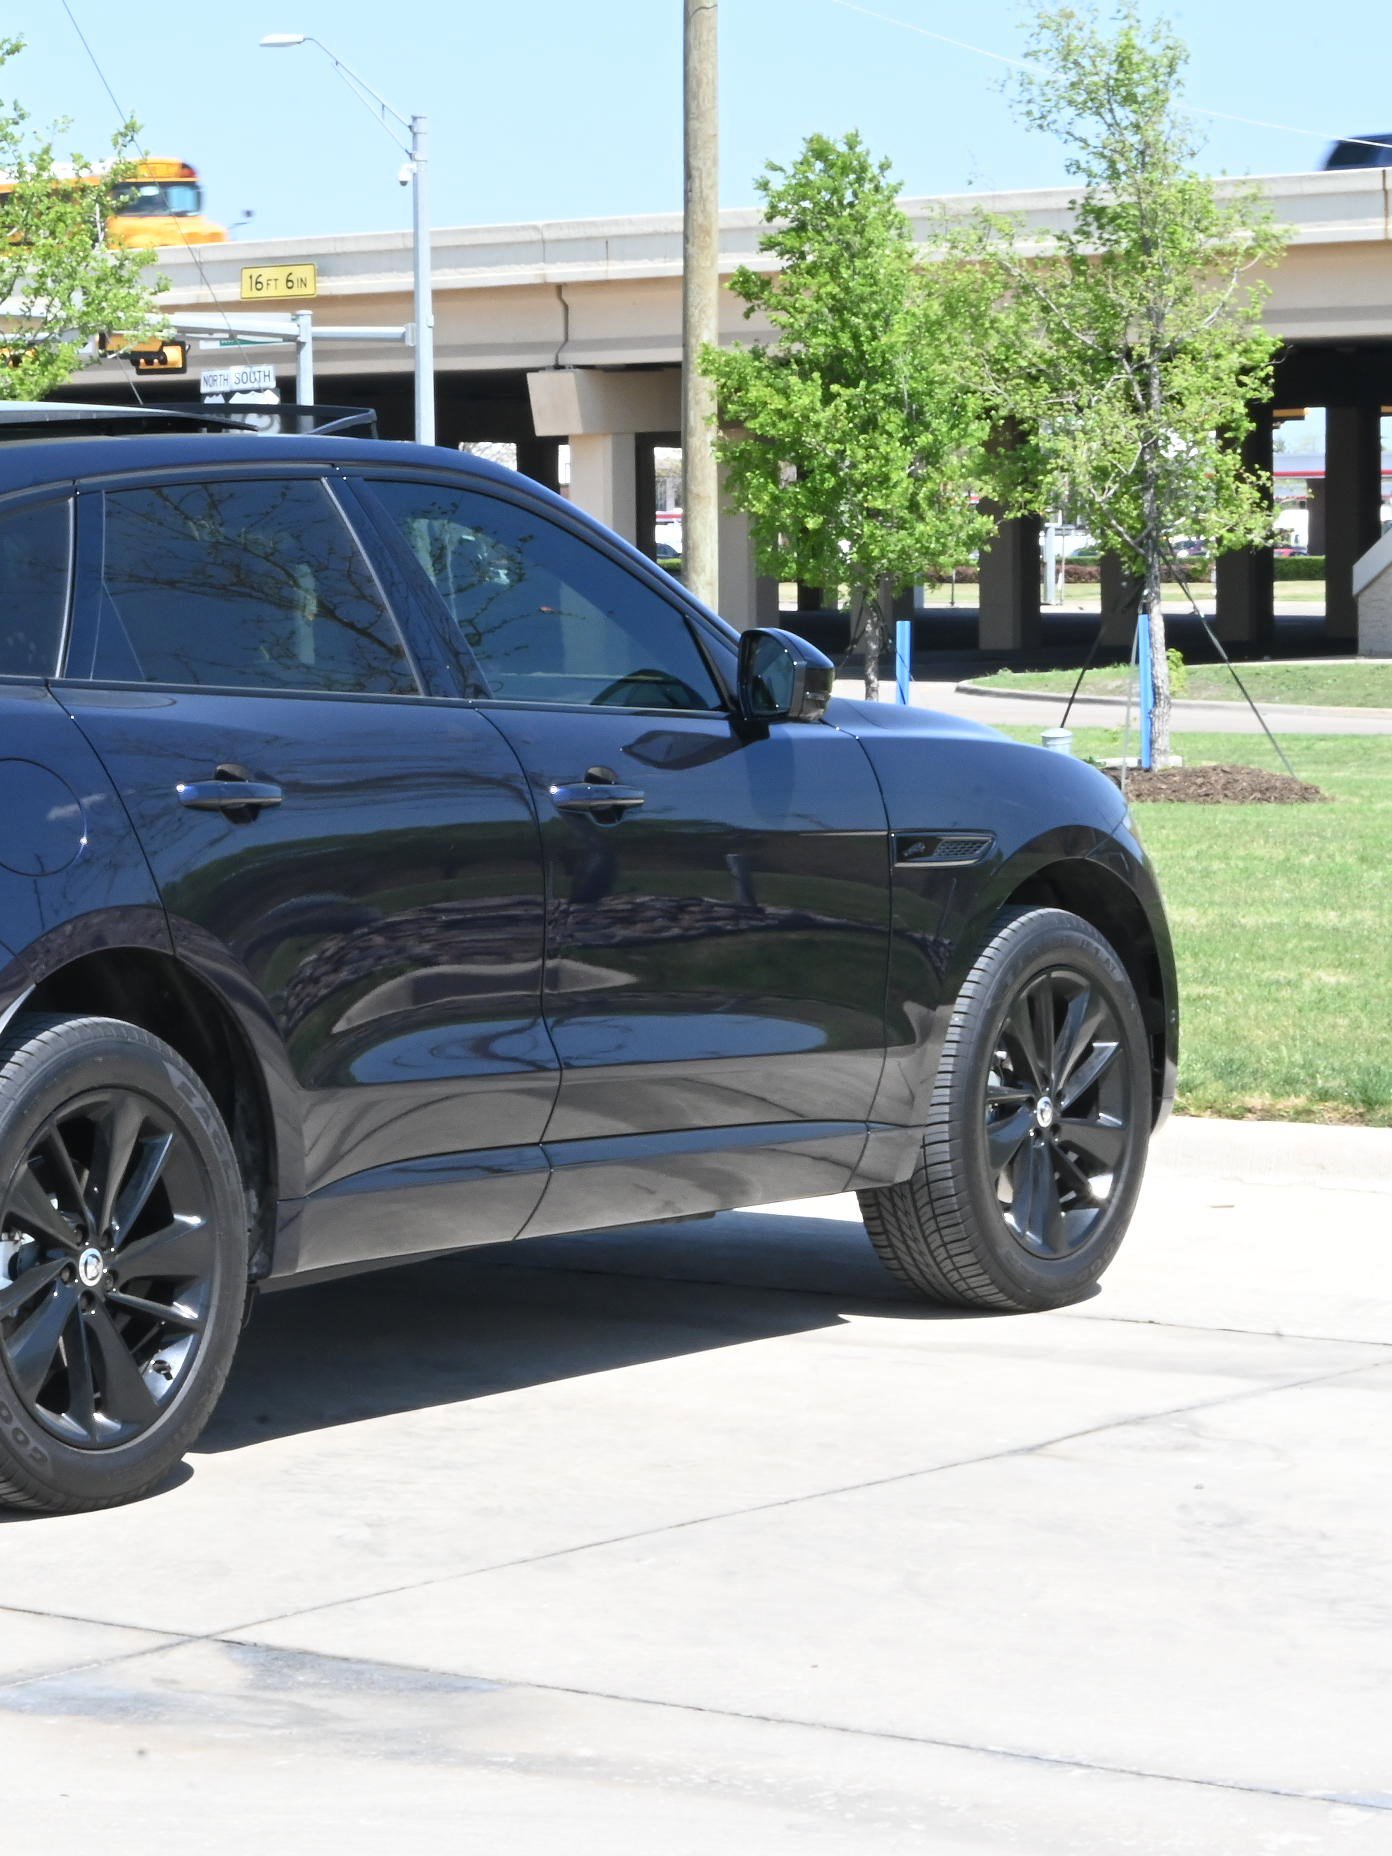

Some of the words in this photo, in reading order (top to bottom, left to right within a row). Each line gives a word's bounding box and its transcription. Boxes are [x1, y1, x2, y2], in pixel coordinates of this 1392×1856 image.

[249, 274, 264, 292] 16
[266, 278, 279, 290] FT
[285, 272, 295, 290] 6
[296, 276, 307, 289] IN
[202, 374, 228, 388] NORTH
[234, 369, 271, 385] SOUTH
